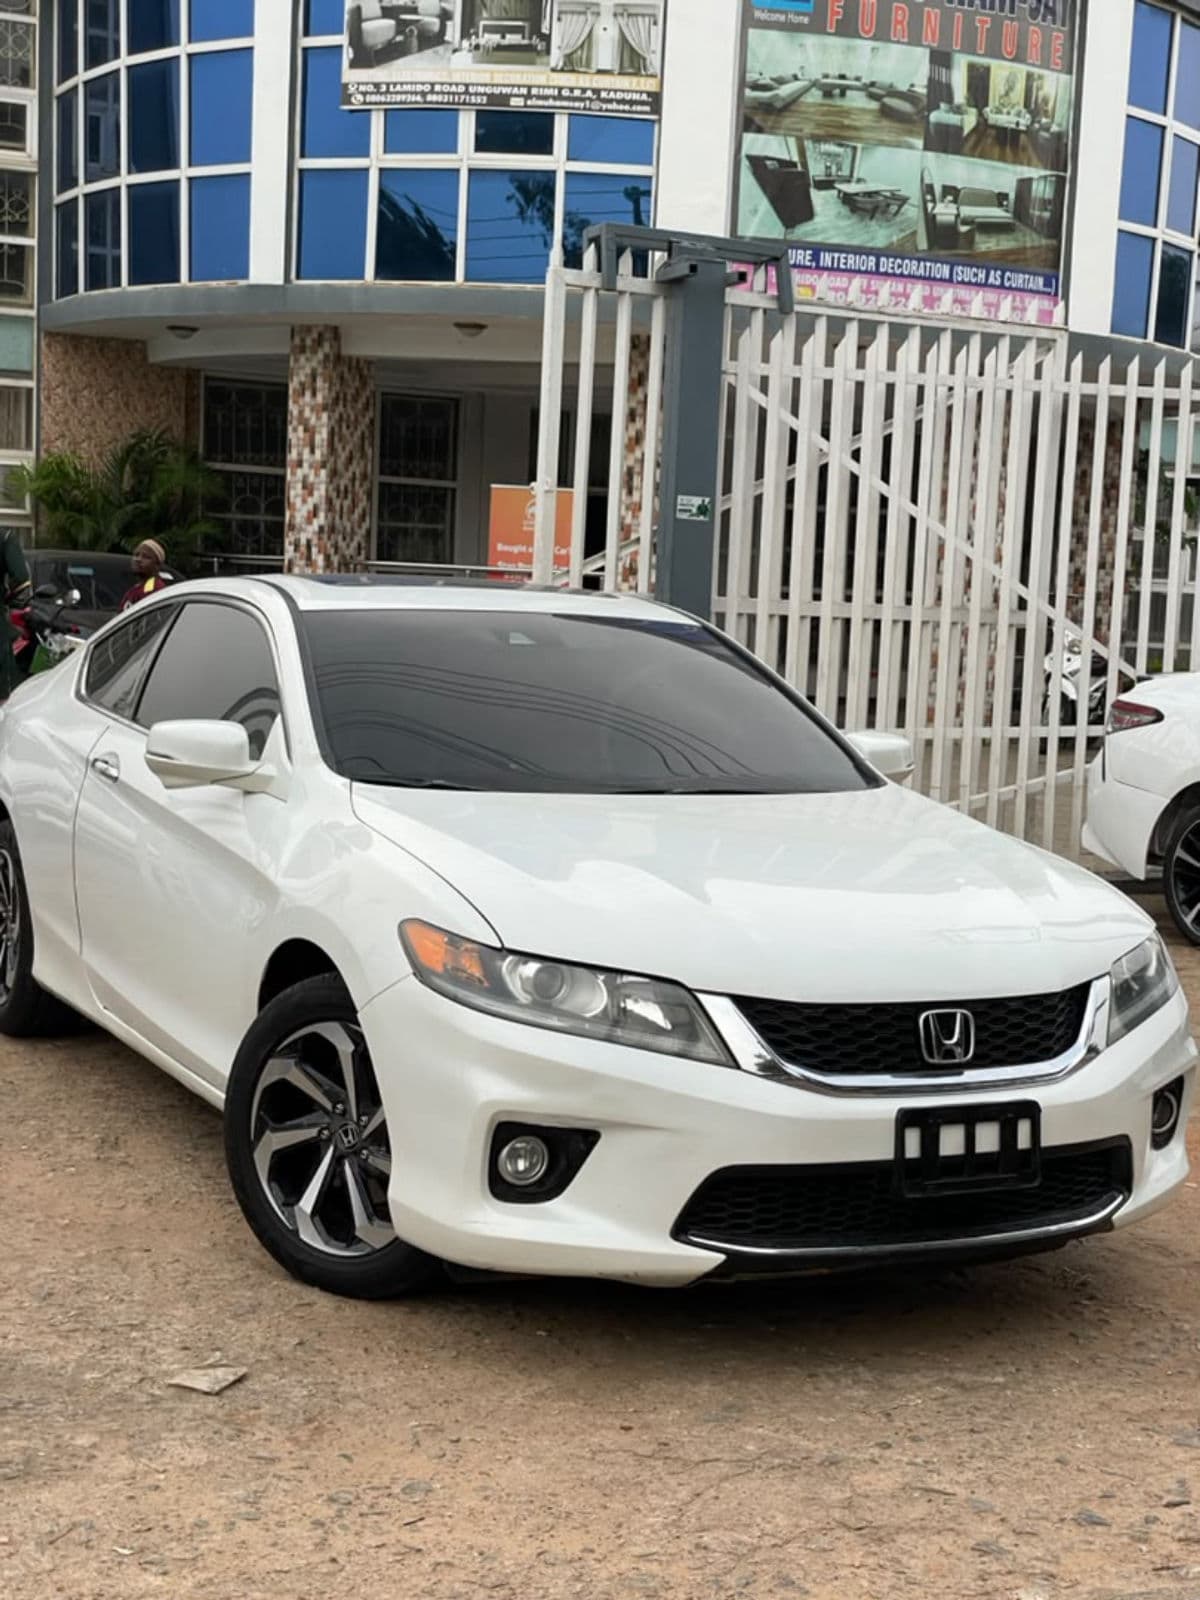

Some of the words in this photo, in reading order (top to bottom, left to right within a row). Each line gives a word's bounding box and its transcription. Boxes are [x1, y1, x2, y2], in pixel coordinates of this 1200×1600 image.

[754, 9, 786, 23] Welcome
[788, 12, 810, 24] Home
[827, 0, 1065, 70] FURNITURE
[358, 84, 377, 92] NO.
[380, 84, 387, 92] 3
[389, 84, 431, 92] LAMIDO
[434, 84, 466, 92] ROAD
[530, 86, 558, 96] RIMI
[788, 249, 816, 269] URE,
[820, 251, 876, 272] INTERIOR
[879, 257, 950, 279] DECORATION
[953, 265, 986, 284] (SUCH
[988, 269, 1002, 285] AS
